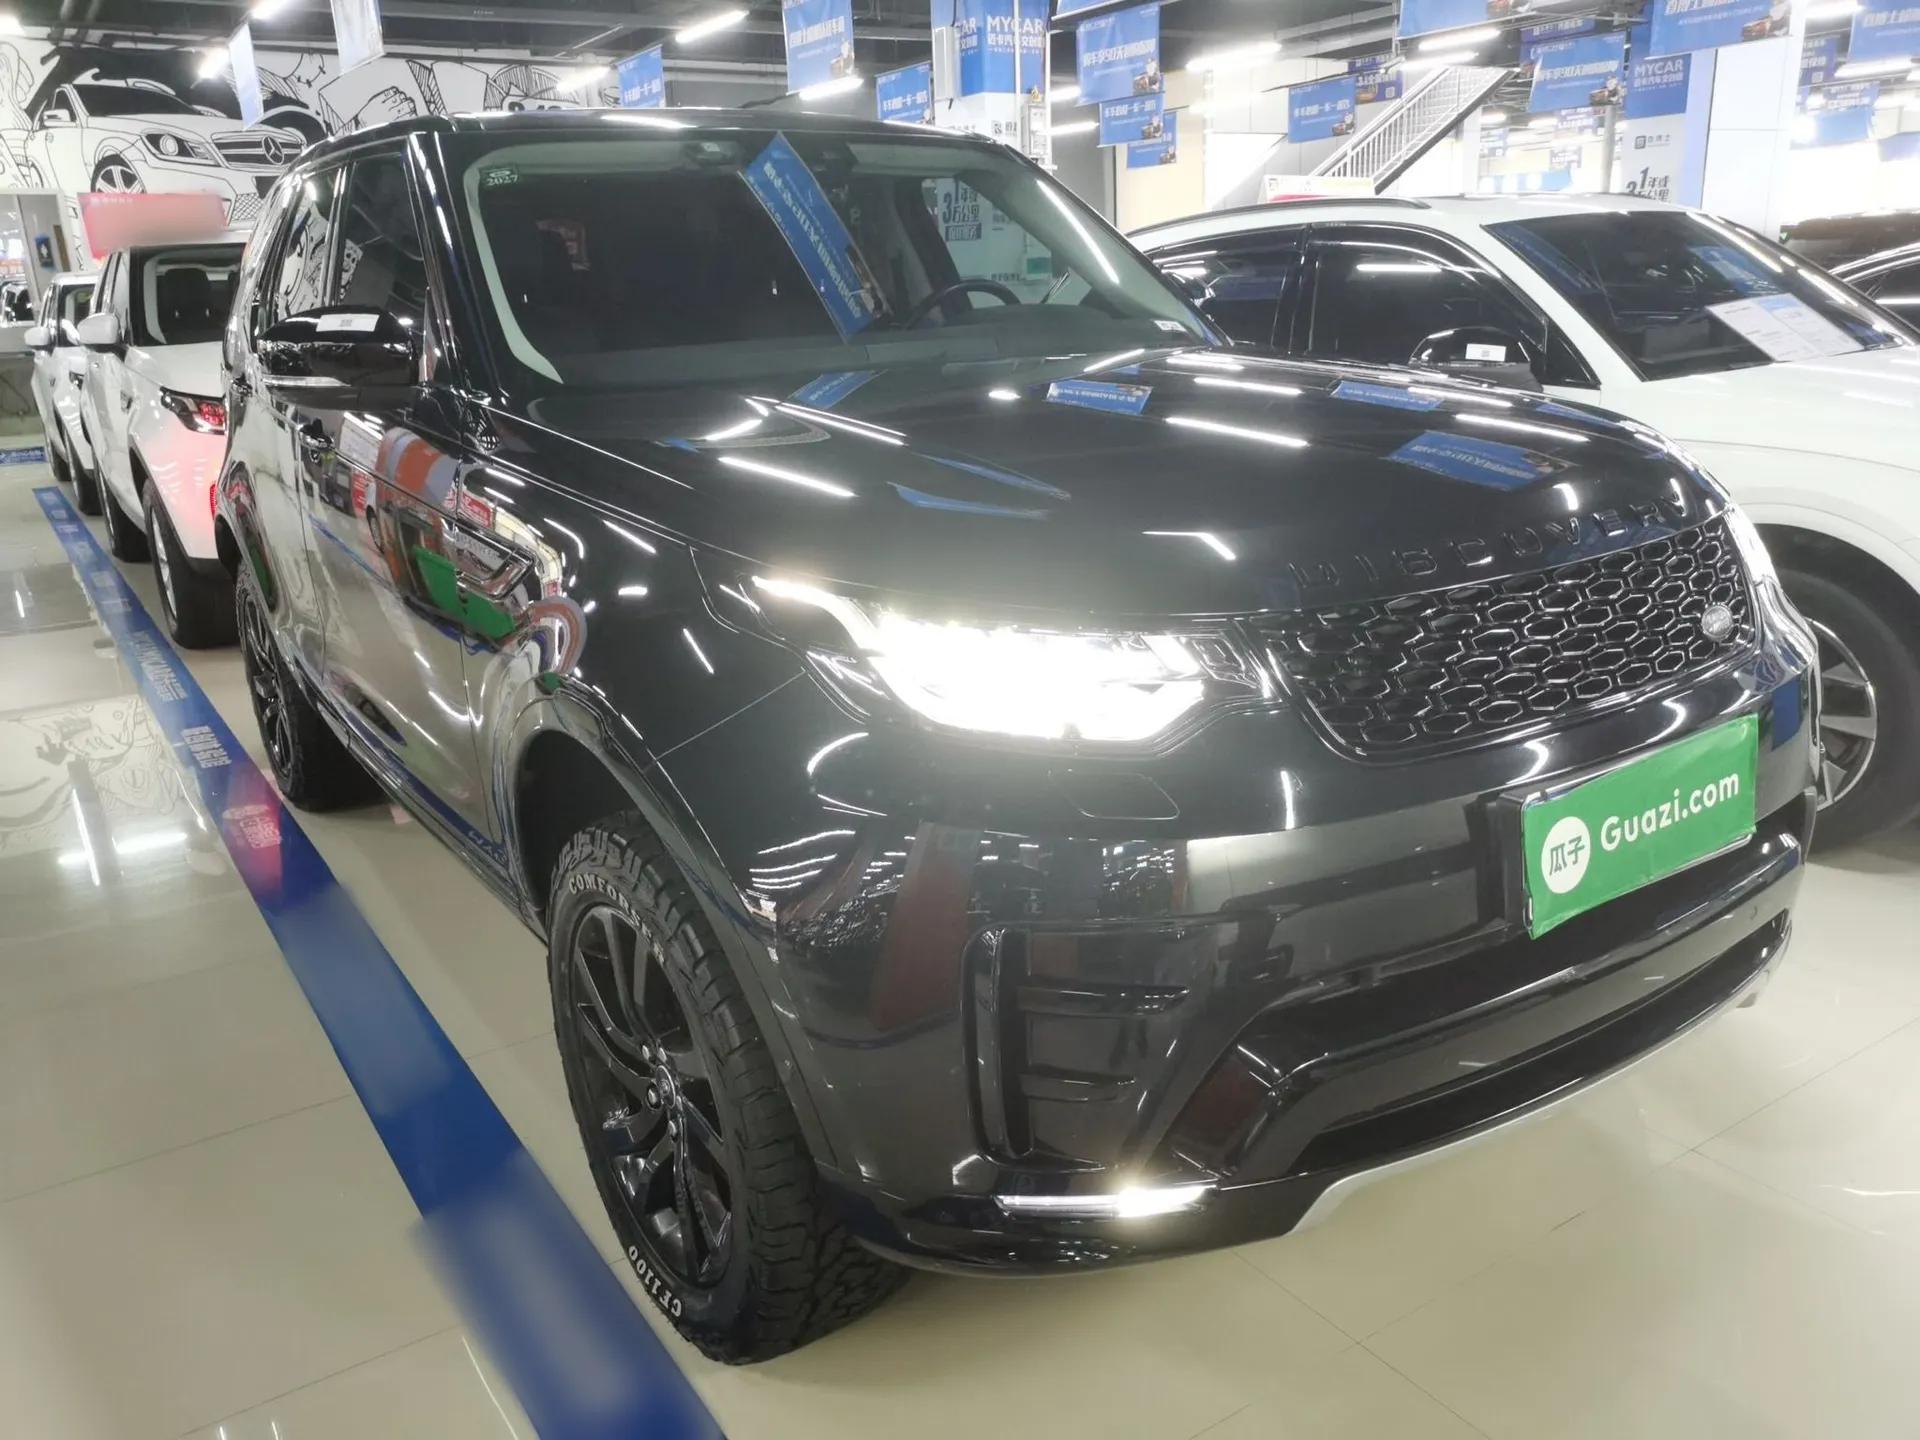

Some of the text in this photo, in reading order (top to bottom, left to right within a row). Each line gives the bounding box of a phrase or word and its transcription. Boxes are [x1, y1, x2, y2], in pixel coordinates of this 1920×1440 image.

[987, 15, 1044, 34] MYCAR
[1634, 59, 1683, 77] MYCAR
[1288, 478, 1687, 588] DISCOVERY
[1601, 773, 1739, 851] Guazi.com
[1549, 834, 1585, 877] 瓜子
[628, 1245, 682, 1317] CF1100
